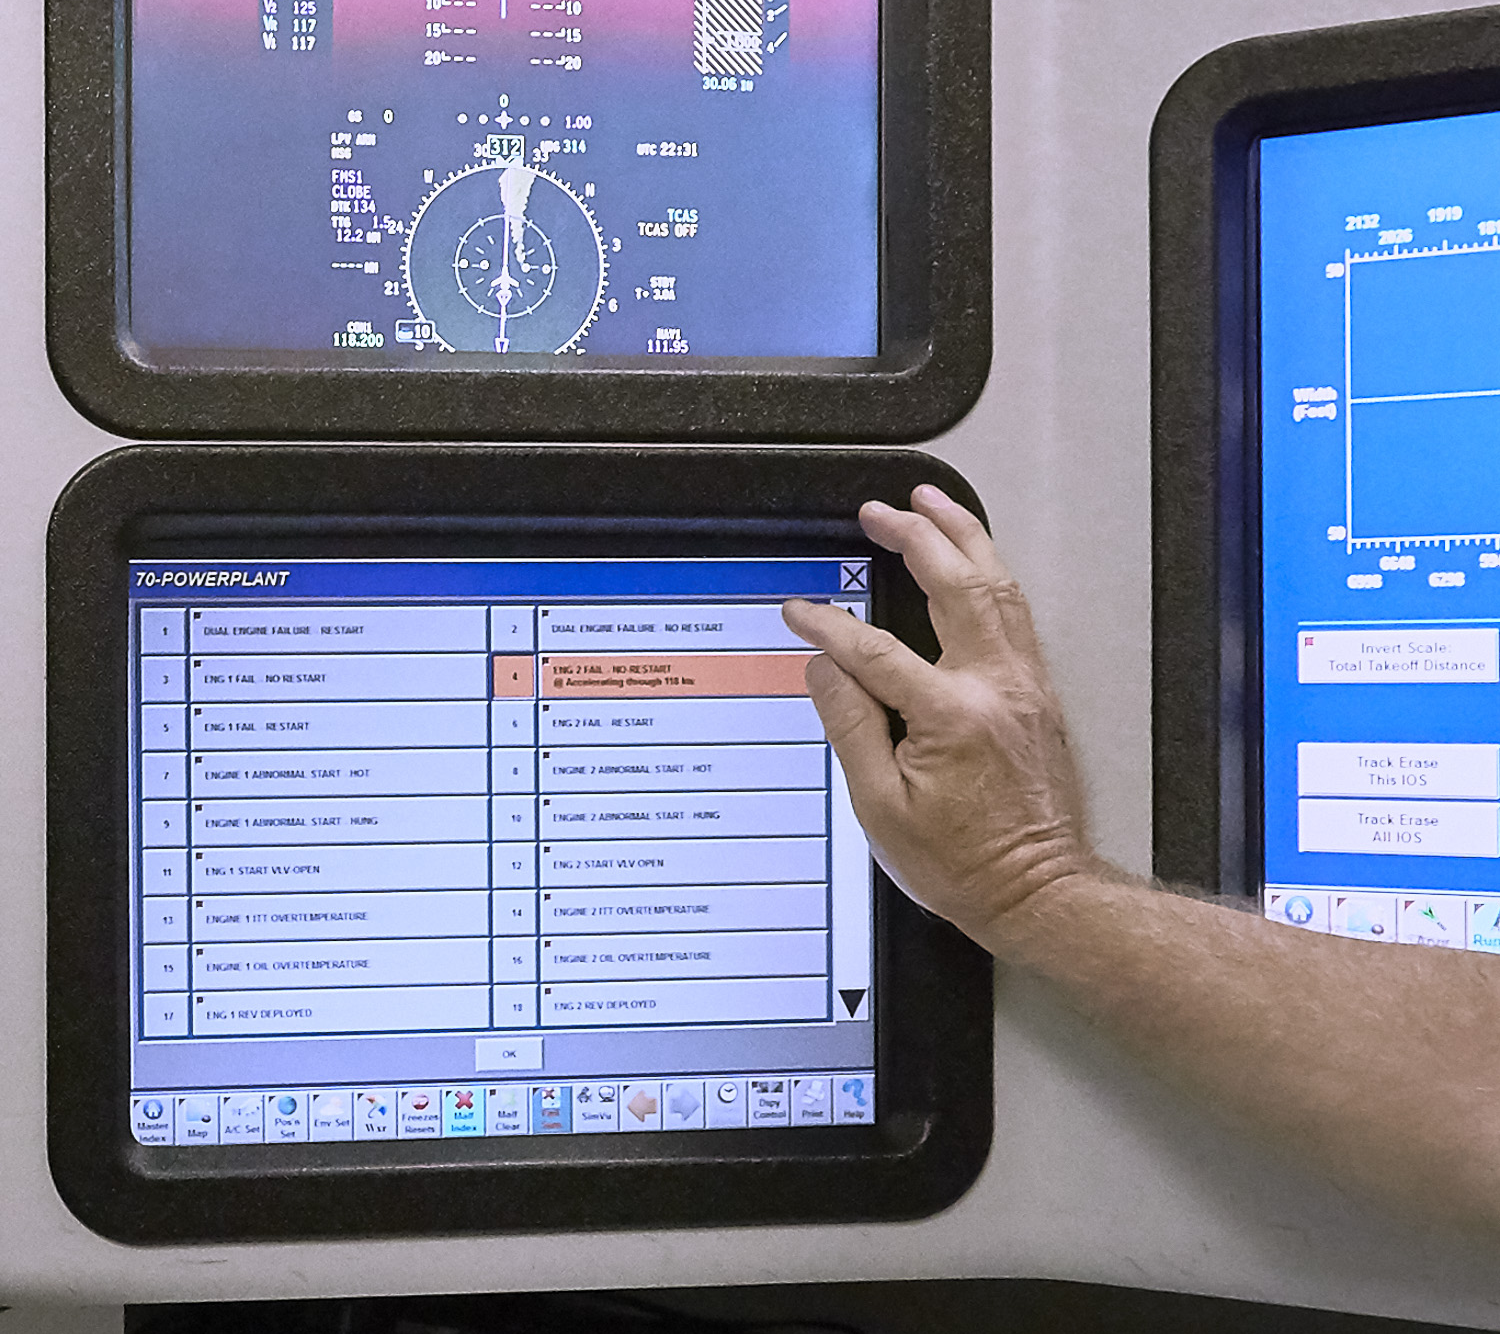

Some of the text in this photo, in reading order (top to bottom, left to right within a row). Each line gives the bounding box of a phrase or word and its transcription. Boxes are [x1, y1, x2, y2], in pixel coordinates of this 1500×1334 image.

[293, 1, 316, 15] 125
[293, 19, 316, 33] 117
[292, 36, 315, 50] 117
[490, 138, 521, 156] 312
[659, 143, 699, 157] 22:31
[331, 169, 363, 184] FMS1
[332, 184, 372, 199] CLOBE
[667, 208, 699, 223] TCAS
[638, 222, 698, 237] TCAS OFF
[333, 332, 385, 348] 118.200
[647, 339, 689, 354] 111.95
[135, 571, 290, 587] 70-POWERPLANT
[1361, 643, 1451, 654] Invert Scale:
[1329, 659, 1486, 672] Total Takeoff Distance
[1358, 756, 1439, 769] Track Erase
[1369, 774, 1427, 786] This IOS
[1358, 813, 1439, 826] Track Erase
[1373, 831, 1422, 844] All IOS
[553, 857, 664, 870] ENG 2 START VLV OPEN
[554, 998, 657, 1011] ENG 2 REV DEPLOYED
[502, 1049, 517, 1059] OK
